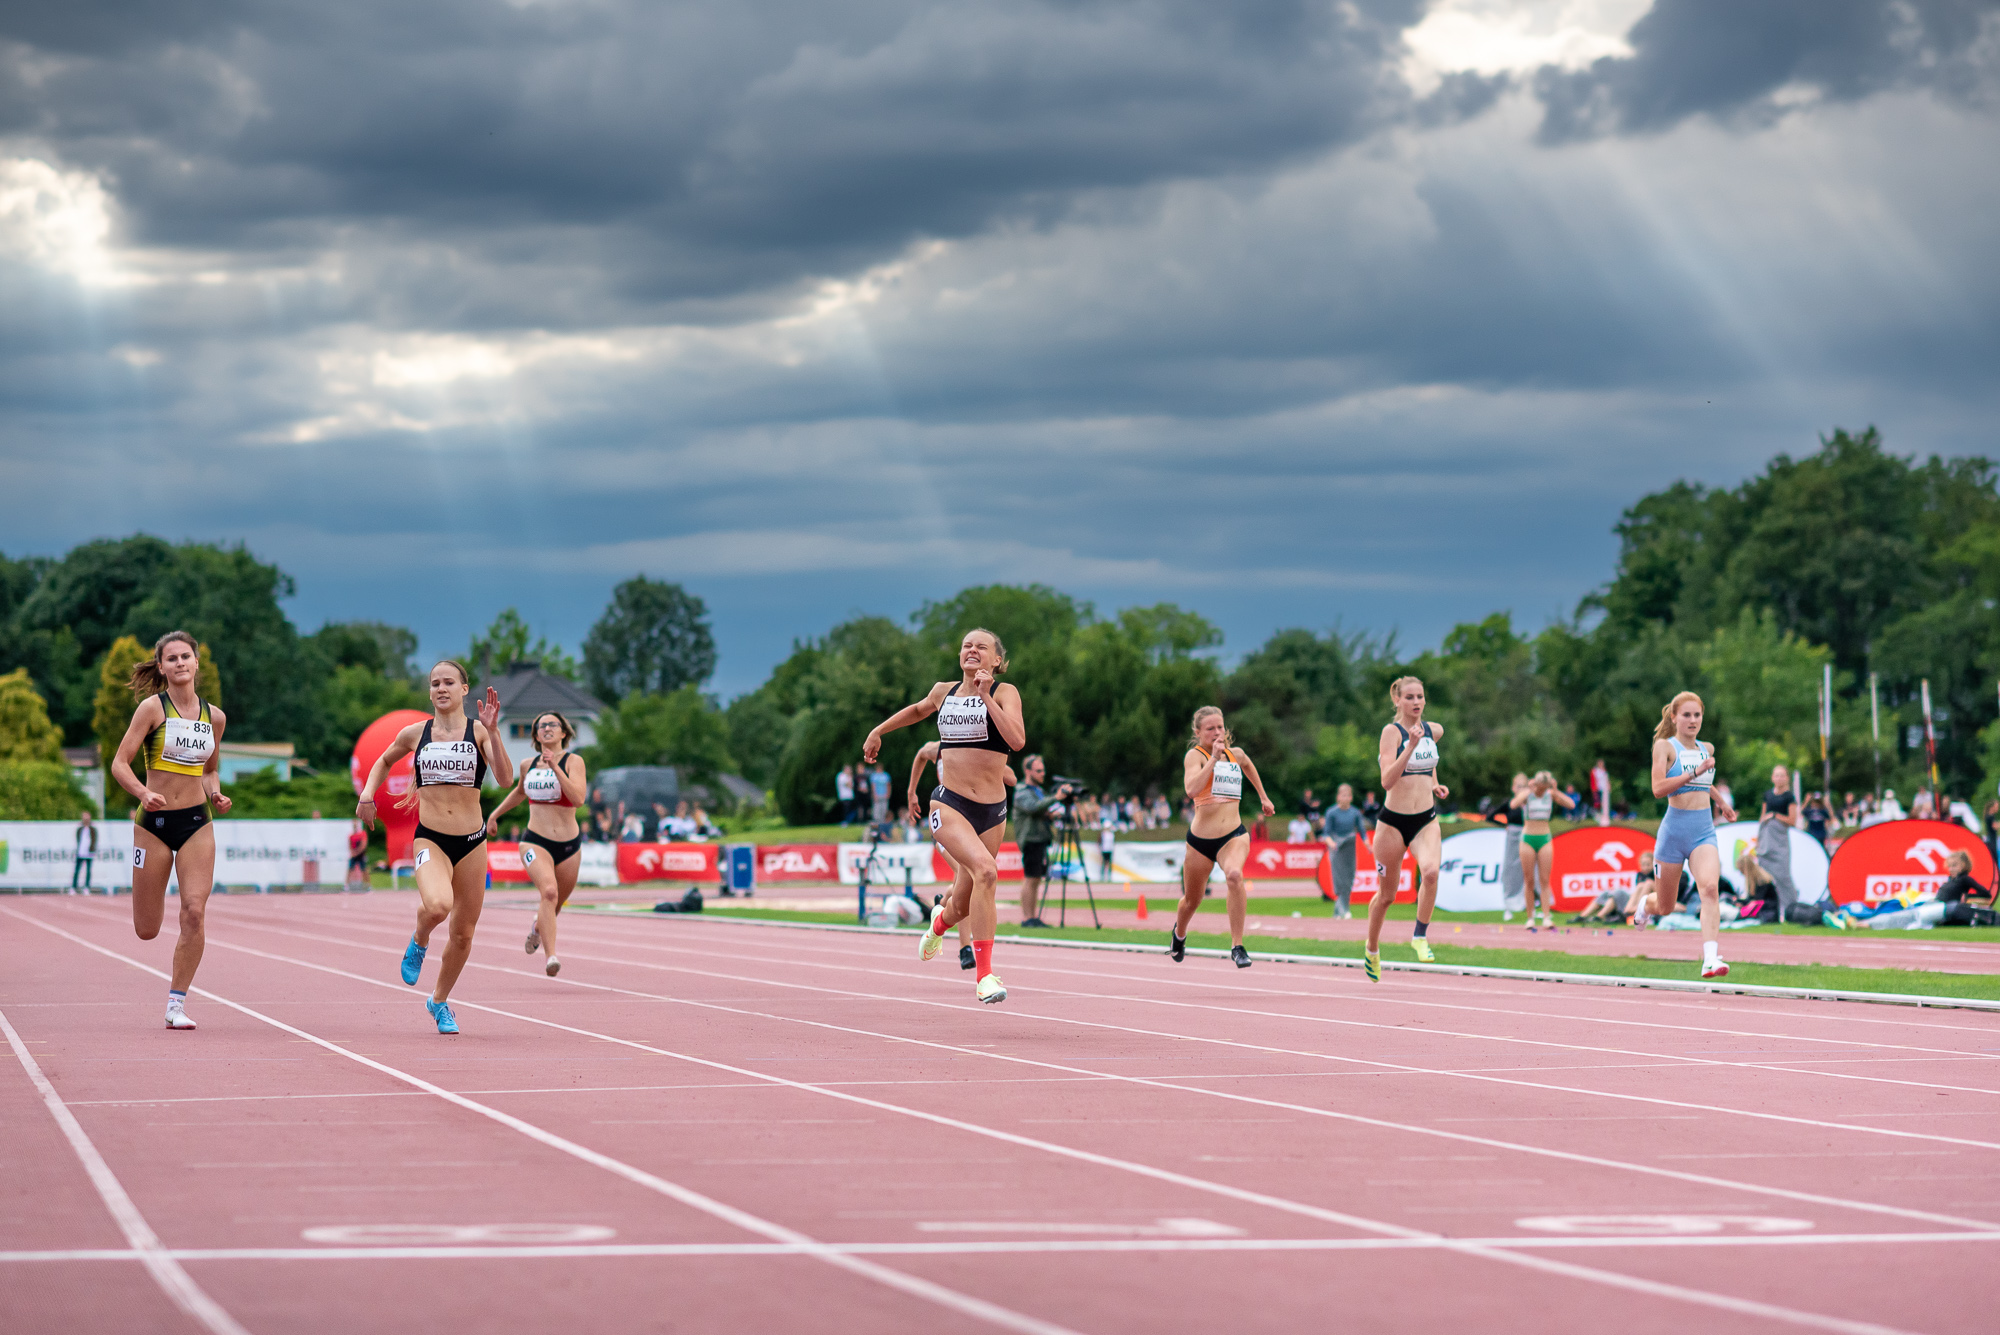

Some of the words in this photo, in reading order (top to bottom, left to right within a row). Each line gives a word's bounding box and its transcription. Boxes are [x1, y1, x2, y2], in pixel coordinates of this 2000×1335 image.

[963, 697, 984, 708] 419
[194, 722, 211, 734] 839
[176, 736, 206, 750] MLAK
[451, 743, 474, 753] 418
[1415, 751, 1433, 760] BLOK
[422, 760, 475, 771] MANDELA
[528, 781, 555, 789] BIELAK
[931, 812, 939, 829] 5
[467, 831, 482, 842] NIKE
[134, 849, 141, 865] 8
[416, 850, 425, 865] 7
[525, 852, 533, 863] 6
[764, 853, 830, 874] PZLA
[1377, 863, 1384, 875] 2
[1568, 878, 1632, 892] ORLEN
